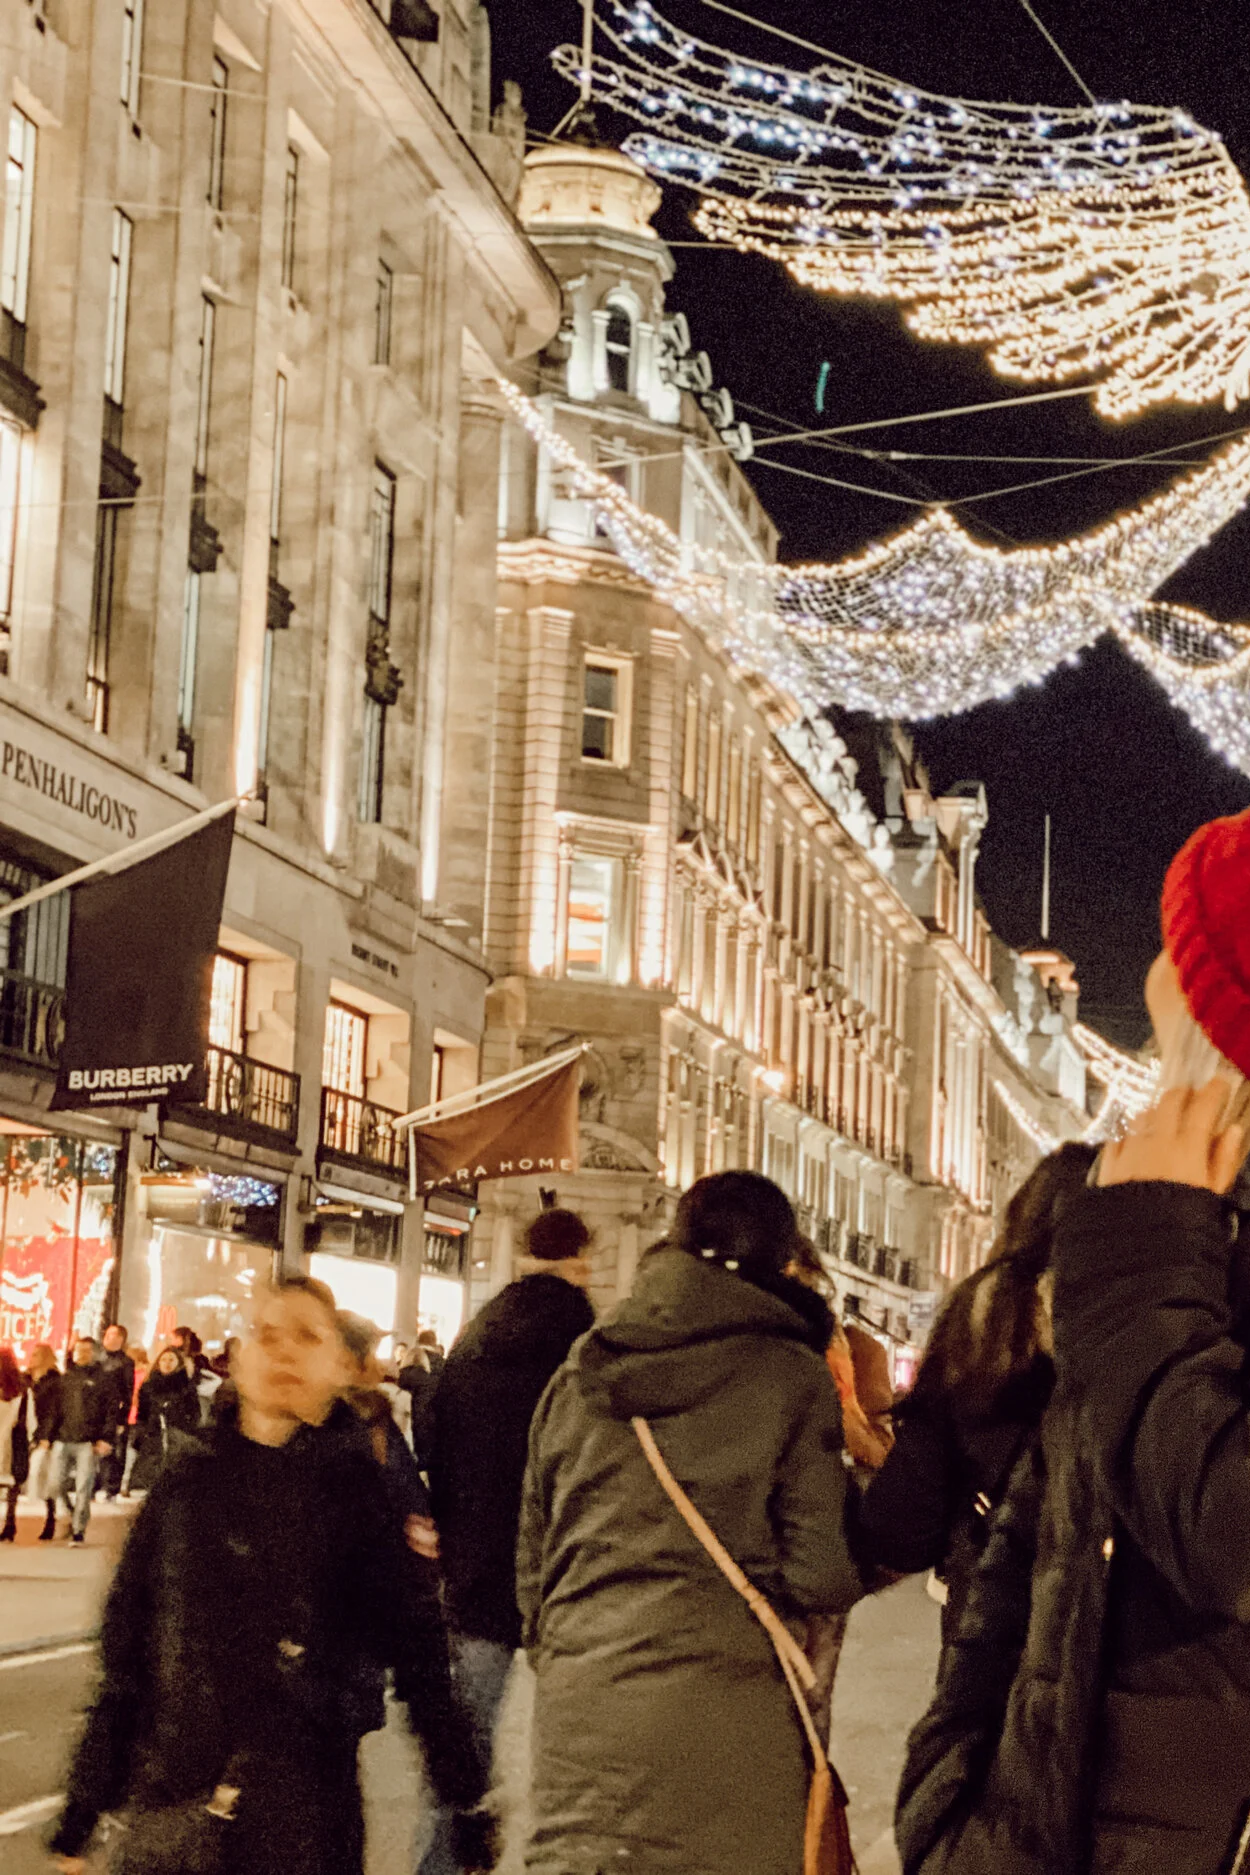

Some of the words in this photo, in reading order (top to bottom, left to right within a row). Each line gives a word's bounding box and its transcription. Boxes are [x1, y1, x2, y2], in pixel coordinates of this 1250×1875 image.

[2, 741, 138, 839] PENHALIGON'S
[68, 1063, 194, 1089] BURBERRY
[90, 1091, 126, 1102] LONDON
[500, 1157, 574, 1172] HOME
